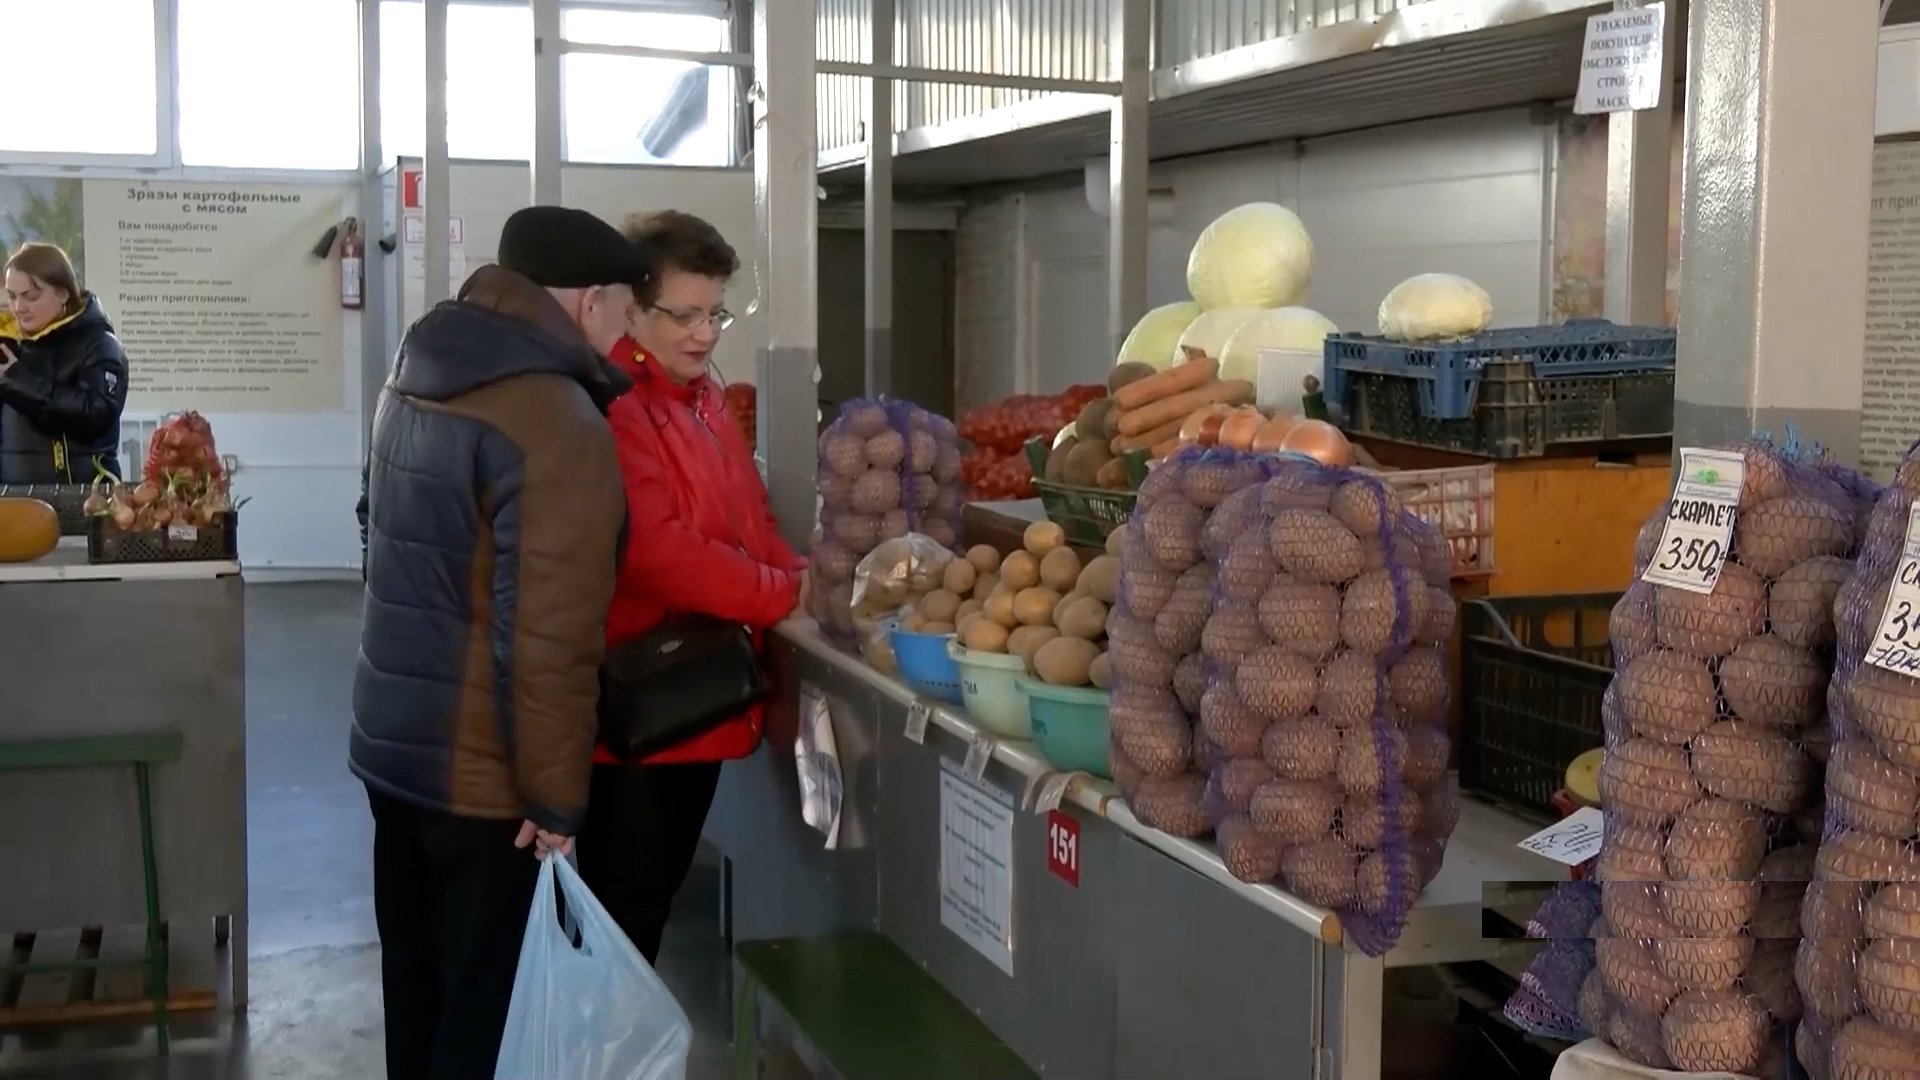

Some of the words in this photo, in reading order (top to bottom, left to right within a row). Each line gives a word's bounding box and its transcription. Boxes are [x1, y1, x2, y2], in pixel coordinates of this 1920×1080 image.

[1594, 14, 1653, 33] УВАЖАЕМЫЕ
[127, 187, 178, 202] Зразы
[182, 191, 302, 205] картофельные
[182, 205, 192, 214] с
[196, 204, 248, 215] мясом
[118, 221, 141, 231] Вам
[119, 293, 158, 305] Рецепт
[1050, 821, 1077, 872] 151
